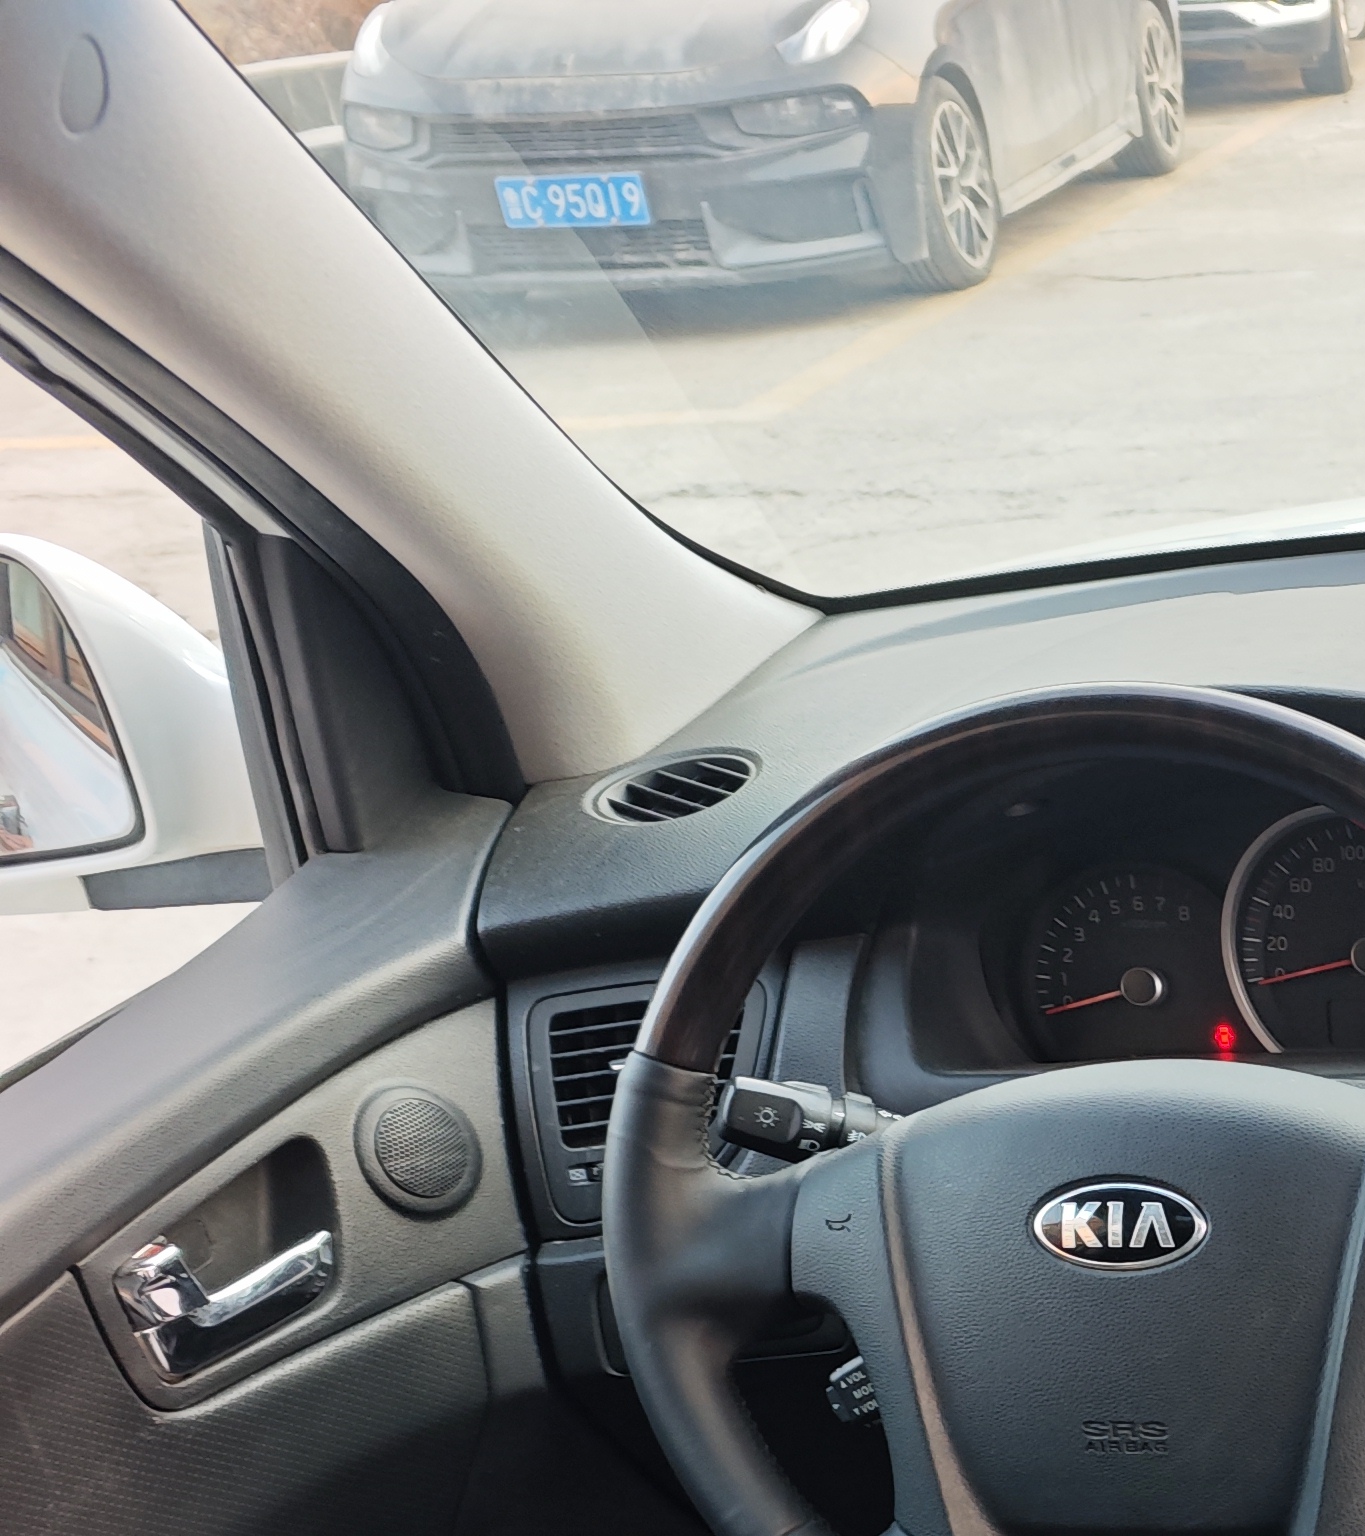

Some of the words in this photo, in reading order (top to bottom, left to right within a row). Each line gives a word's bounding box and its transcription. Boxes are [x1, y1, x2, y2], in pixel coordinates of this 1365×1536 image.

[1340, 845, 1365, 860] 100
[1313, 858, 1335, 873] 80
[1289, 877, 1312, 893] 60
[1109, 899, 1121, 914] 5
[1132, 895, 1144, 911] 6
[1154, 895, 1166, 911] 7
[1088, 909, 1101, 923] 4
[1178, 905, 1191, 921] 8
[1273, 904, 1295, 920] 40
[1073, 926, 1085, 942] 3
[1266, 936, 1288, 951] 20
[1062, 948, 1073, 963] 2
[1060, 971, 1068, 986] 1
[1060, 1200, 1176, 1249] KIA
[1081, 1419, 1170, 1440] SRS
